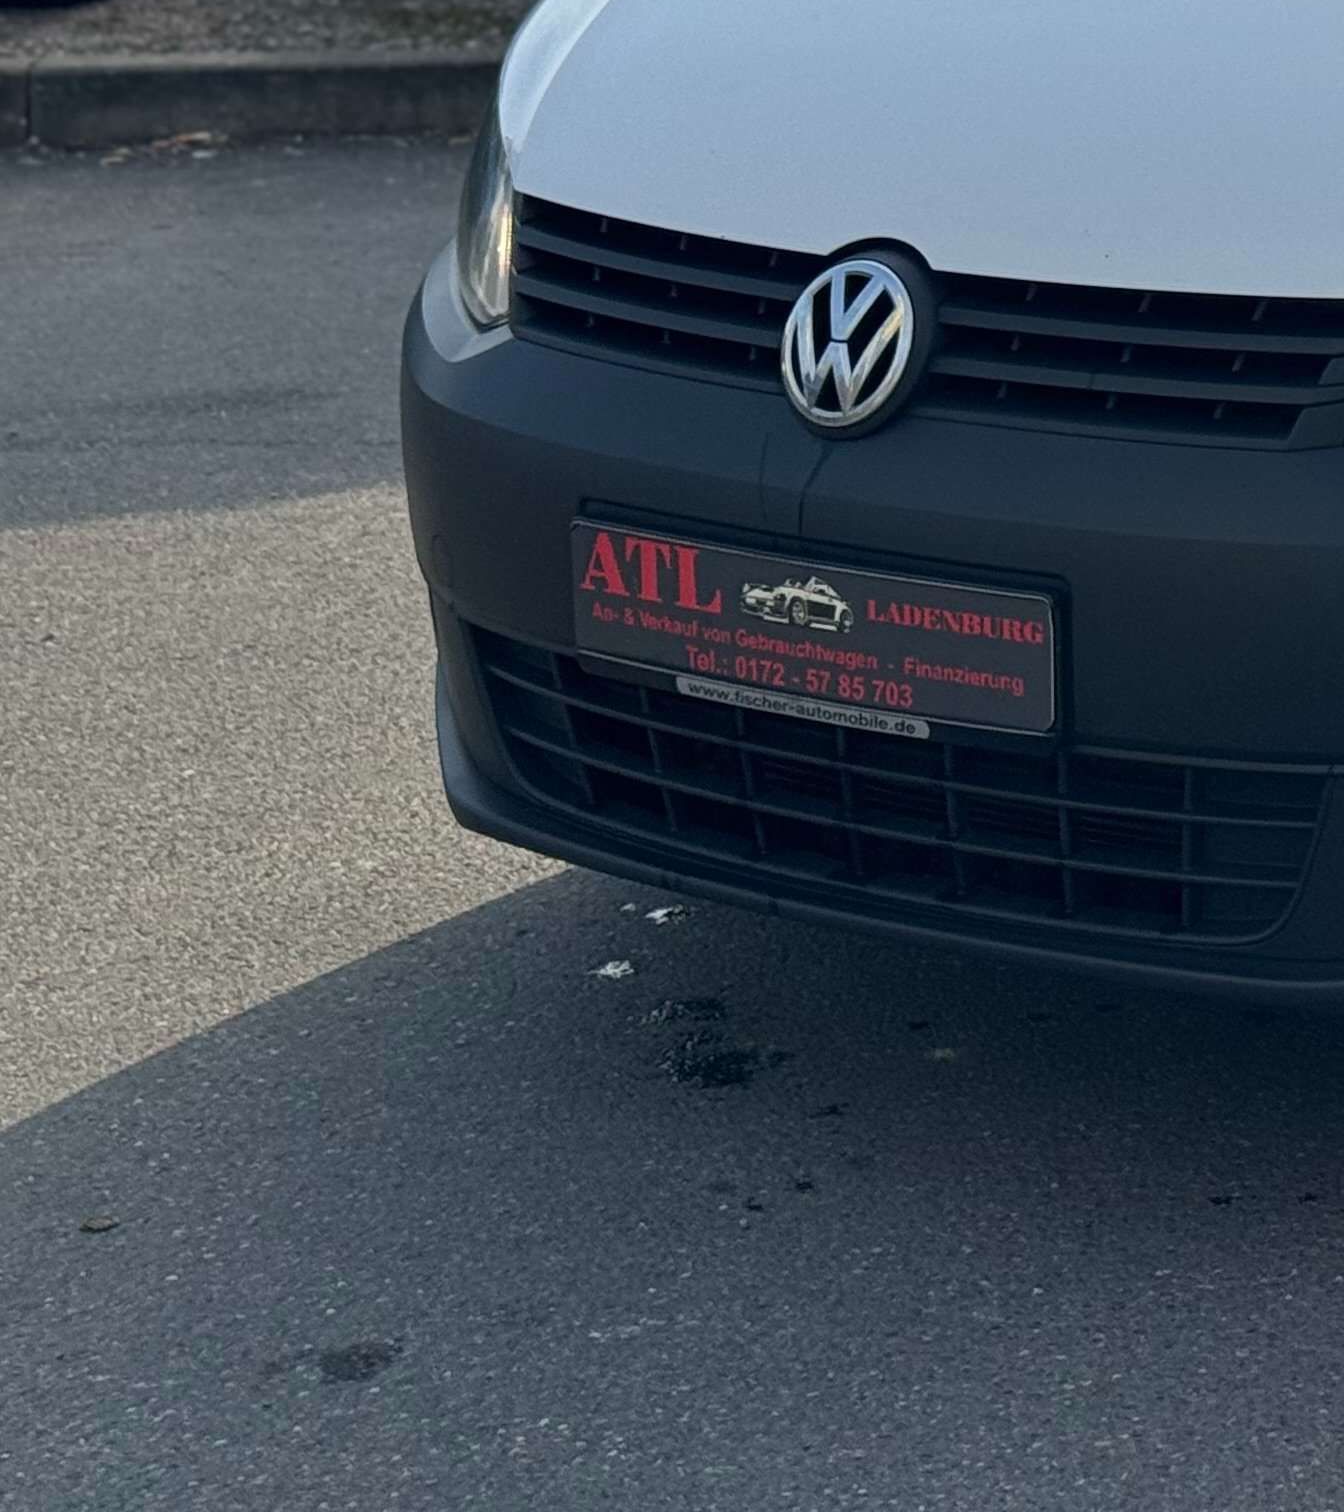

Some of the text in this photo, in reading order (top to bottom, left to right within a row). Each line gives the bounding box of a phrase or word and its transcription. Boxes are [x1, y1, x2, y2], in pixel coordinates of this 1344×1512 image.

[580, 529, 1044, 645] ATL LADENBURG
[592, 601, 619, 623] An-
[623, 607, 634, 626] &
[639, 611, 699, 637] Verkauf
[702, 625, 731, 644] von
[736, 628, 878, 671] Gebrauchtwagen
[904, 656, 1025, 697] Finanzierung
[686, 644, 729, 675] Tel.:
[735, 655, 785, 687] 0172
[805, 668, 832, 694] 57
[837, 674, 865, 701] 85
[871, 678, 913, 709] 703
[688, 681, 917, 735] www.fischer-automobile.de
